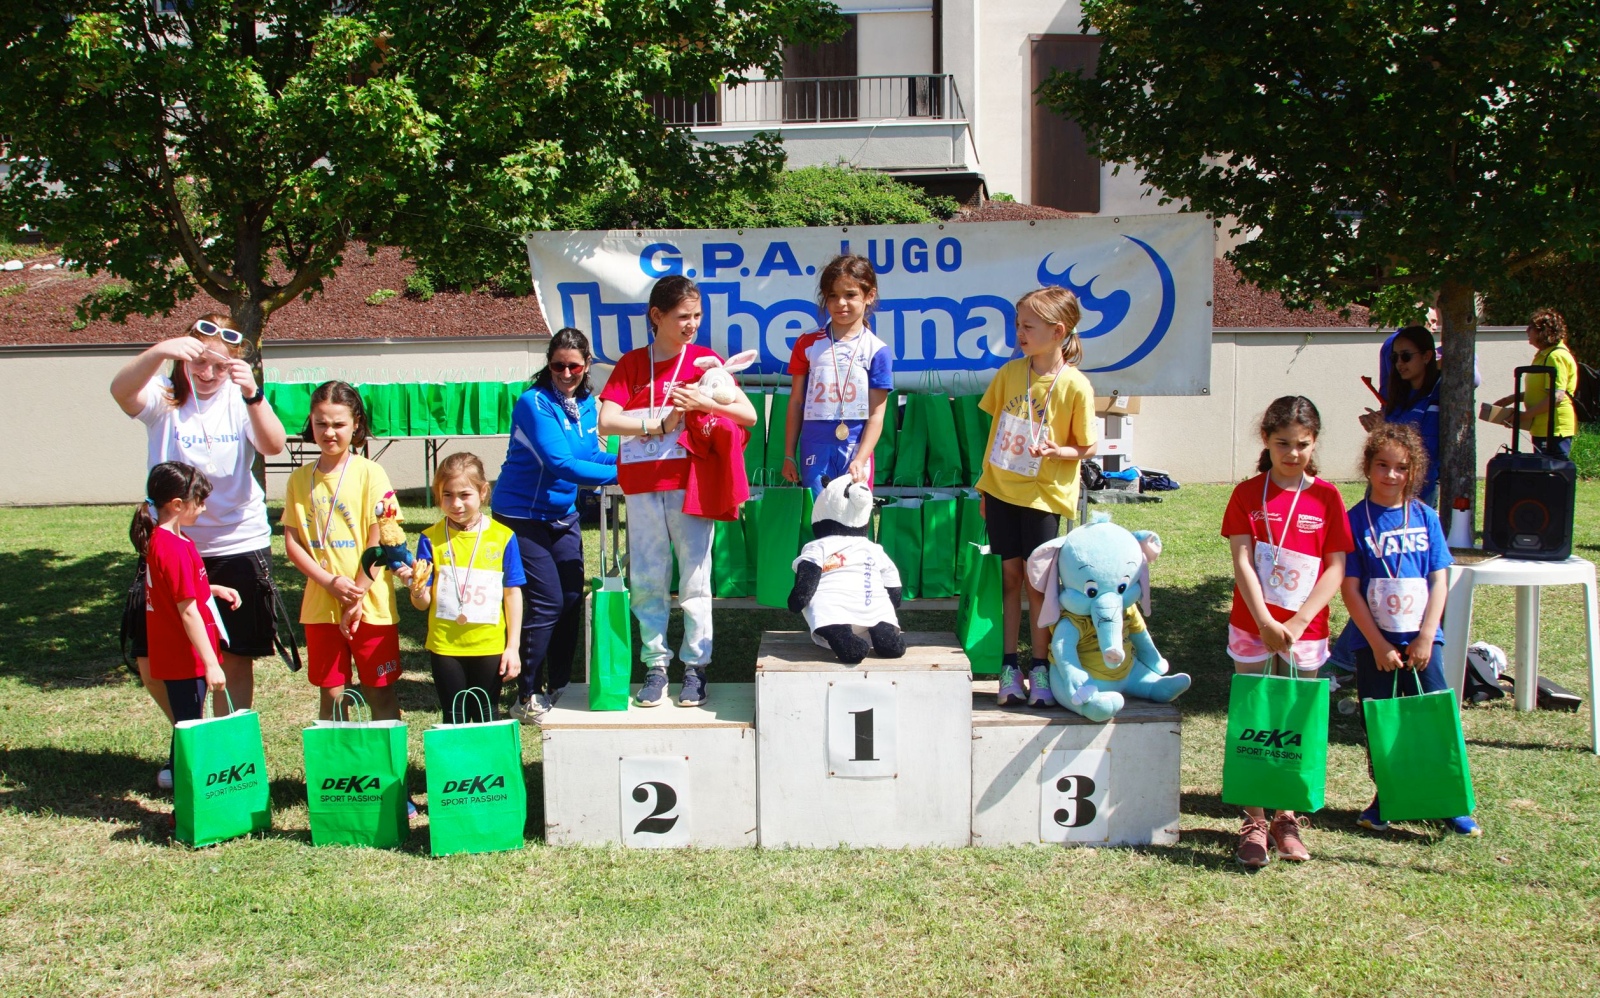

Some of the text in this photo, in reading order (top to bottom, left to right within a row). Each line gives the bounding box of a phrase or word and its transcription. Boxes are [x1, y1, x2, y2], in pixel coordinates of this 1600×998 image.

[639, 240, 816, 279] G.P.A.
[814, 382, 857, 404] 259
[1000, 431, 1027, 456] 58
[1365, 527, 1429, 558] VANS
[1271, 564, 1301, 592] 53
[460, 584, 487, 606] 55
[1386, 594, 1414, 616] 92
[377, 660, 397, 677] GAP
[848, 707, 880, 762] 1
[1239, 728, 1302, 748] DEKA
[1236, 746, 1264, 756] SPORT
[1264, 748, 1303, 761] PASSION
[206, 762, 256, 787] DEKA
[321, 775, 381, 793] DEKA
[442, 773, 505, 795] DEKA
[205, 780, 258, 800] SPORT PASSION
[320, 794, 383, 803] SPORT PASSION
[441, 793, 508, 807] SPORT PASSION
[1053, 774, 1097, 828] 3
[632, 781, 680, 835] 2
